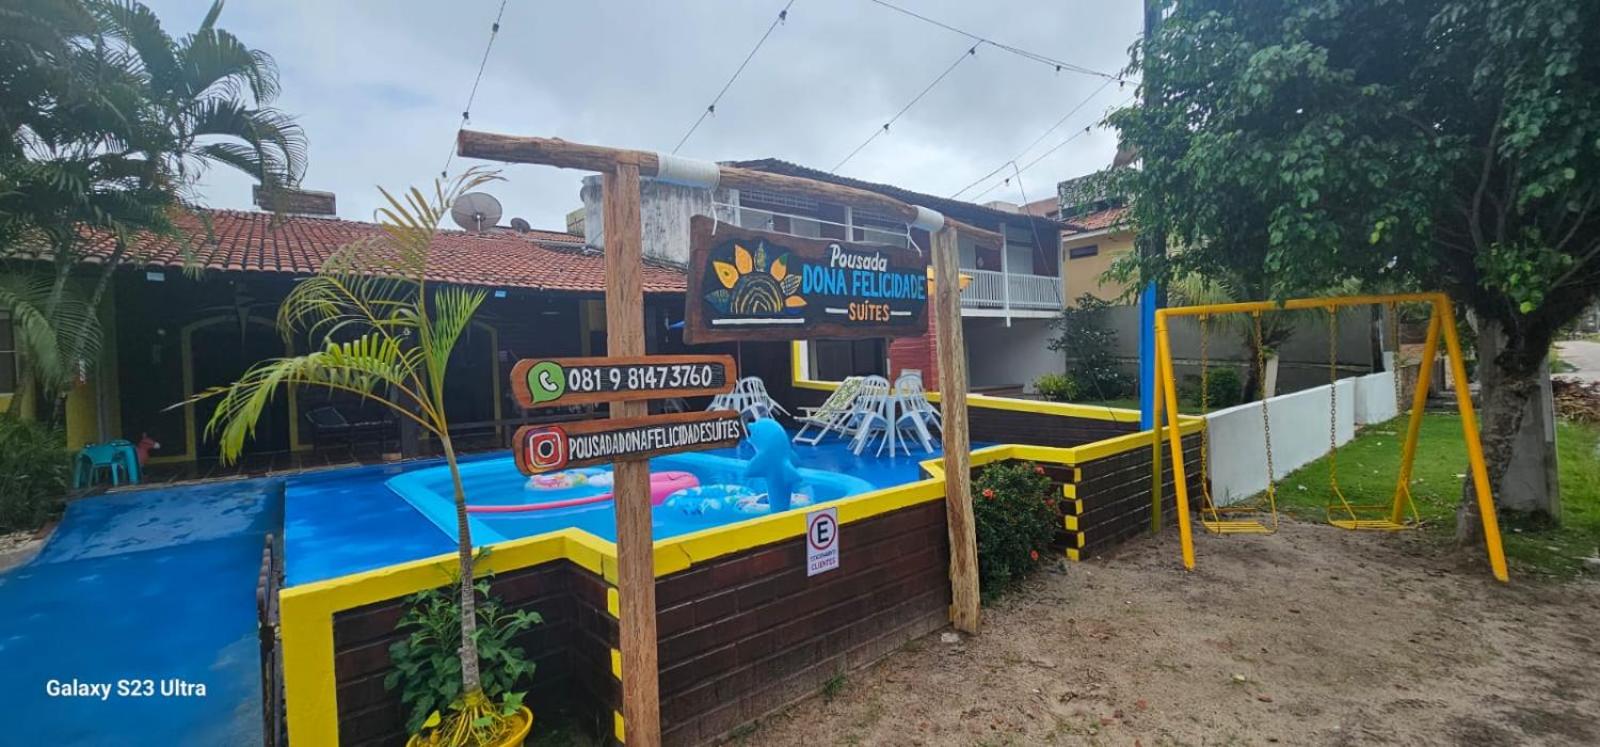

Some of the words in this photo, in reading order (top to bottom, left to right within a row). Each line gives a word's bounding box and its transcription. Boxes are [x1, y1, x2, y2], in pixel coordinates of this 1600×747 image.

[829, 244, 887, 272] Pousada
[802, 264, 848, 296] DONA
[852, 270, 926, 300] FELICIDADE
[848, 300, 890, 321] SUÍTES
[568, 368, 601, 391] 081
[609, 368, 621, 390] 9
[817, 520, 829, 544] E
